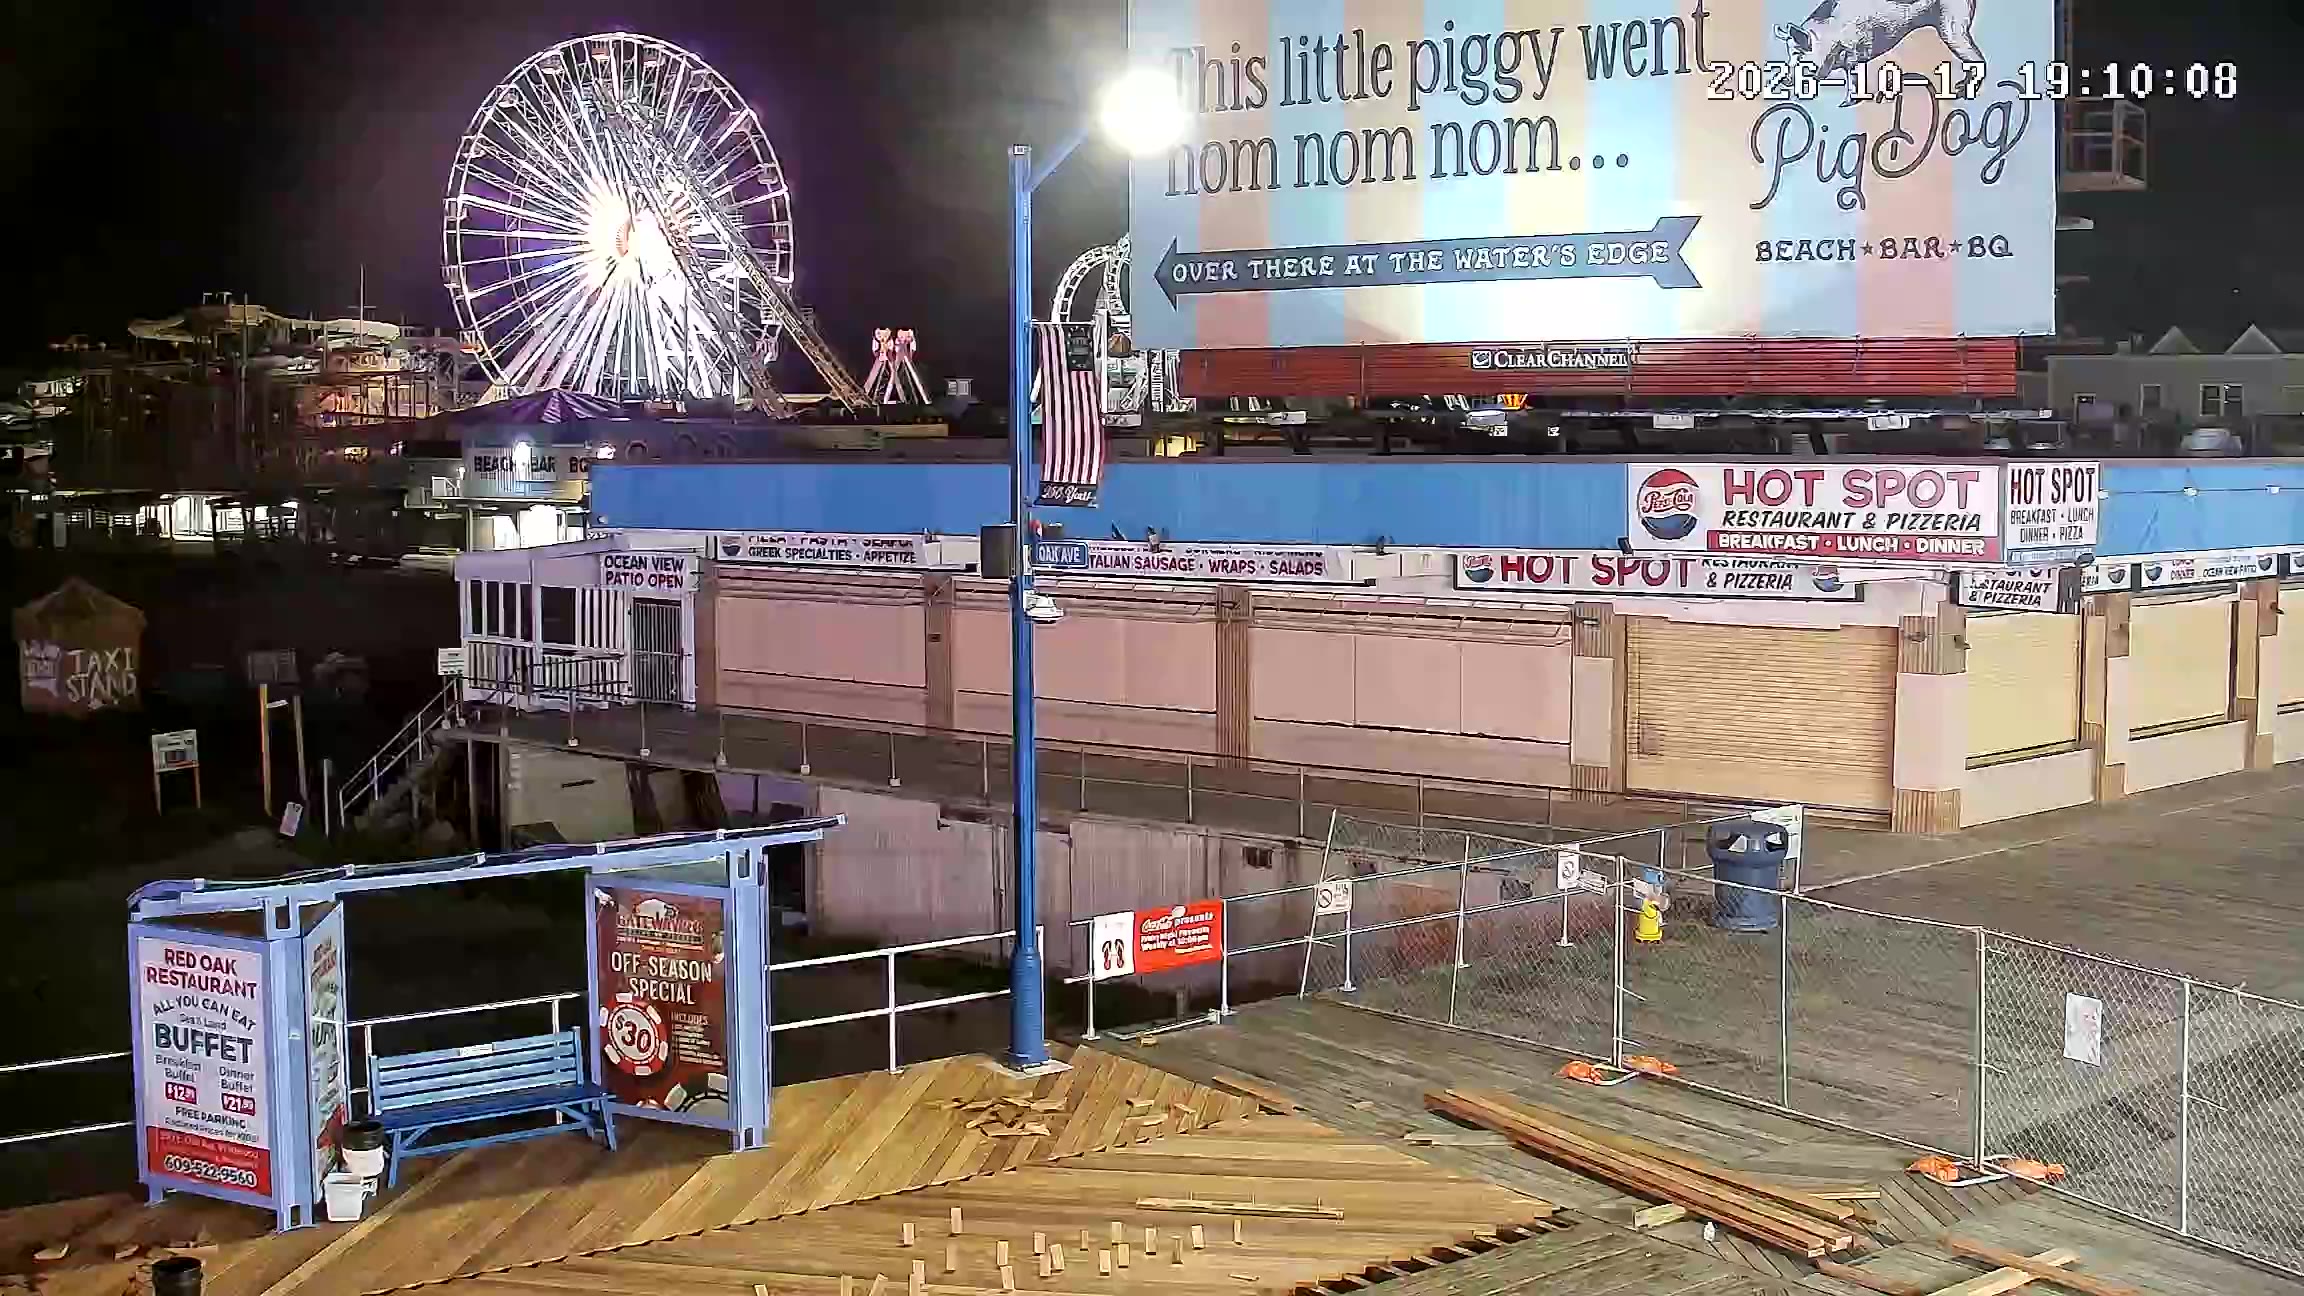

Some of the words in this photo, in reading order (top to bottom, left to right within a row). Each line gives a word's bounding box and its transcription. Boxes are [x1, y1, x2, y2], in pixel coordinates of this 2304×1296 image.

[1170, 42, 1267, 113] This
[1279, 29, 1393, 106] little
[1406, 20, 1564, 111] piggy
[1578, 0, 1713, 80] went
[1165, 133, 1281, 197] nom
[1293, 122, 1416, 188] nom
[1429, 113, 1630, 178] nom...
[1755, 239, 1857, 263] BEACH
[1880, 237, 1946, 260] BAR
[1967, 234, 2014, 258] BQ
[1172, 260, 1238, 284] OVER
[1248, 256, 1335, 280] THERE
[1343, 253, 1380, 276] AT
[1388, 250, 1444, 273] THE
[1453, 241, 1577, 272] WATER'S
[1586, 240, 1670, 266] EDGE
[474, 455, 516, 473] BEACH
[1723, 468, 1825, 507] HOT
[1842, 468, 1980, 509] SPOT
[2010, 467, 2046, 505] HOT
[2051, 466, 2096, 505] SPOT
[1721, 508, 1855, 531] RESTAURANT
[1862, 512, 1876, 530] &
[1885, 511, 1982, 532] PIZZERIA
[2010, 508, 2057, 525] BREAKFAST
[2067, 507, 2095, 524] LUNCH
[1718, 533, 1821, 552] BREAKFAST
[1837, 535, 1900, 553] LUNCH
[1915, 537, 1986, 556] DINNER
[2019, 527, 2049, 543] DINNER
[2058, 525, 2084, 542] PIZZA
[604, 555, 648, 571] OCEAN
[651, 556, 684, 573] VIEW
[747, 546, 784, 559] GREEK
[785, 547, 853, 562] SPECIALTIES
[1038, 545, 1060, 562] OAK
[1060, 544, 1081, 563] AVE
[1088, 553, 1131, 569] TALIAN
[1134, 556, 1196, 573] SAUSAGE
[1208, 558, 1256, 575] WRAPS
[1268, 560, 1324, 577] SALADS
[604, 571, 644, 588] PATIO
[647, 573, 684, 590] OPEN
[1500, 555, 1577, 584] HOT
[1591, 554, 1699, 588] SPOT
[1705, 573, 1718, 588] &
[1723, 572, 1794, 591] PIZZERIA
[1968, 590, 1978, 603] &
[1983, 590, 2043, 607] PIZZERIA
[66, 648, 137, 672] TAXI
[66, 672, 137, 703] STAND
[164, 947, 197, 969] RED
[199, 954, 238, 977] OAK
[146, 965, 257, 1000] RESTAURANT
[629, 977, 696, 1006] SPECIAL
[152, 999, 175, 1017] ALL
[176, 994, 199, 1009] YOU
[201, 997, 230, 1018] CAN
[231, 1007, 257, 1032] EAT
[154, 1022, 254, 1064] BUFFET
[220, 1078, 254, 1094] Buffet
[175, 1105, 200, 1121] FREE
[200, 1110, 249, 1130] PARKING
